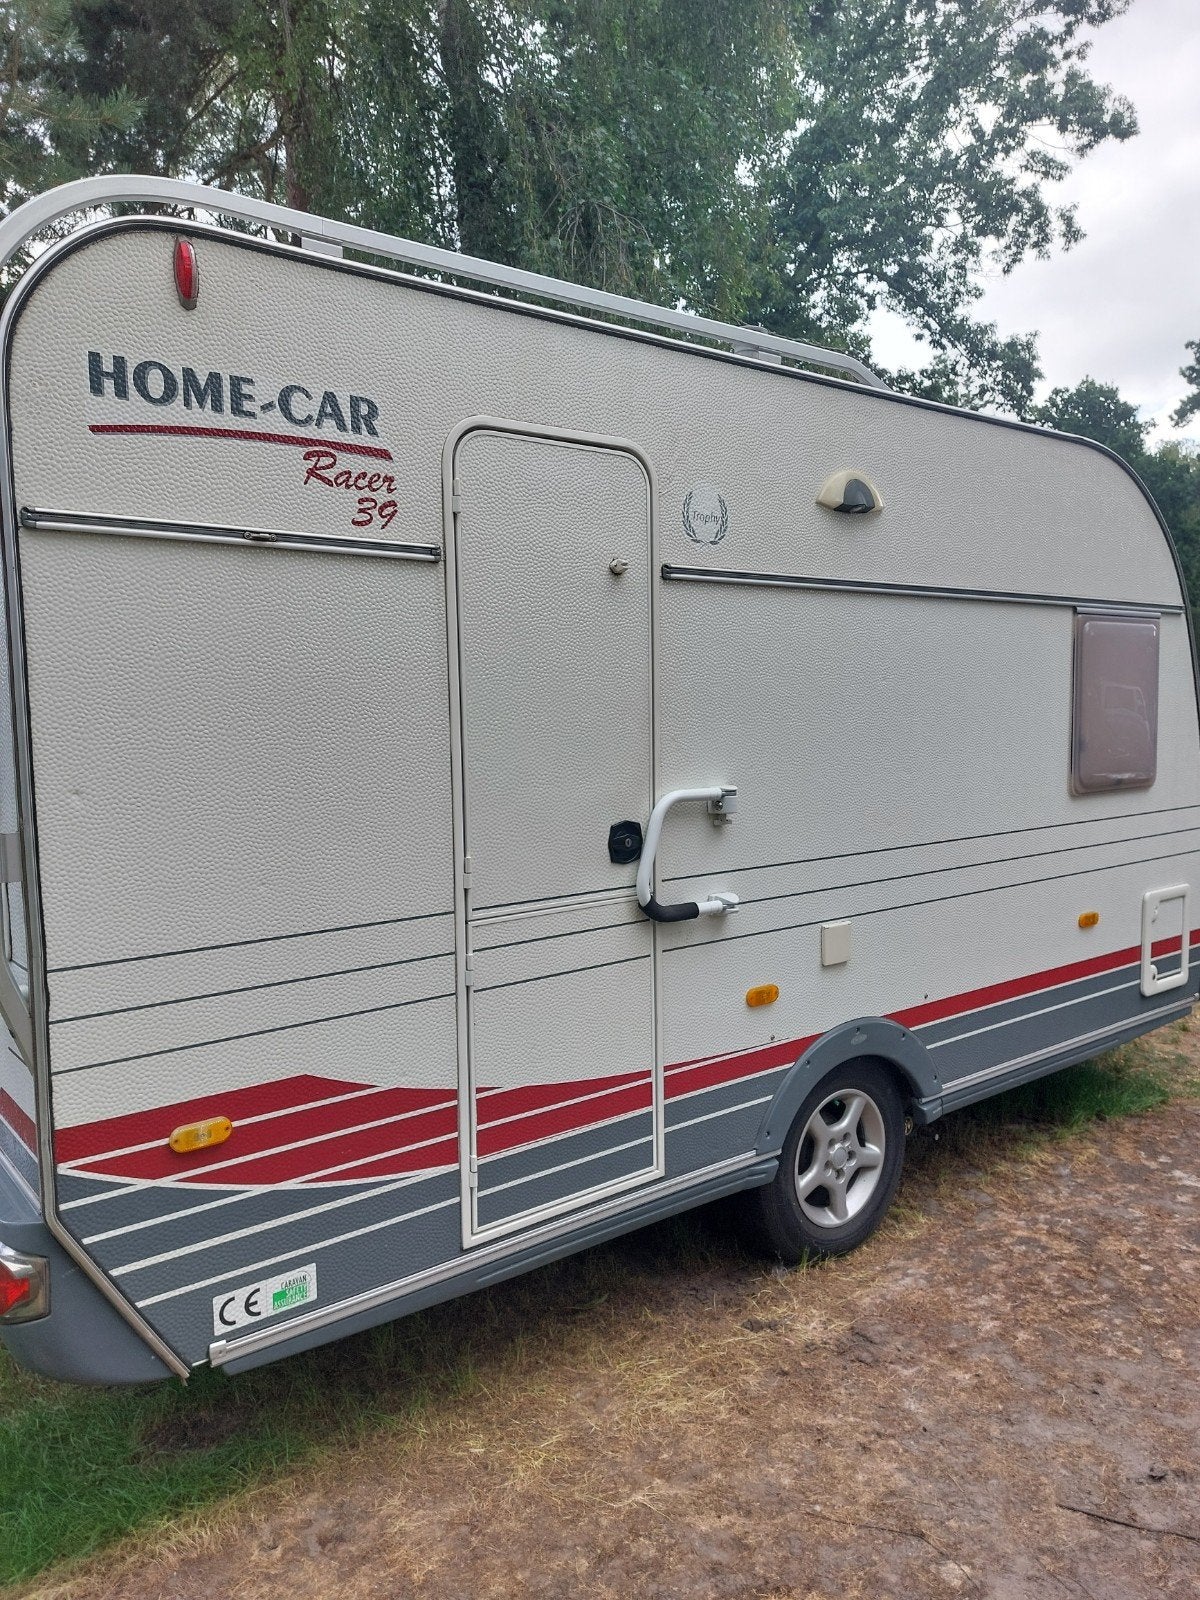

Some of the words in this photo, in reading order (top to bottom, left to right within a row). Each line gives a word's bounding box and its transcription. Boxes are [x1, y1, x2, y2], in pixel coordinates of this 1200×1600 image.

[88, 351, 380, 437] HOME-CAR
[303, 450, 397, 494] Racer
[350, 497, 398, 529] 39
[693, 511, 720, 525] Trophy
[281, 1275, 307, 1289] CARAVAN
